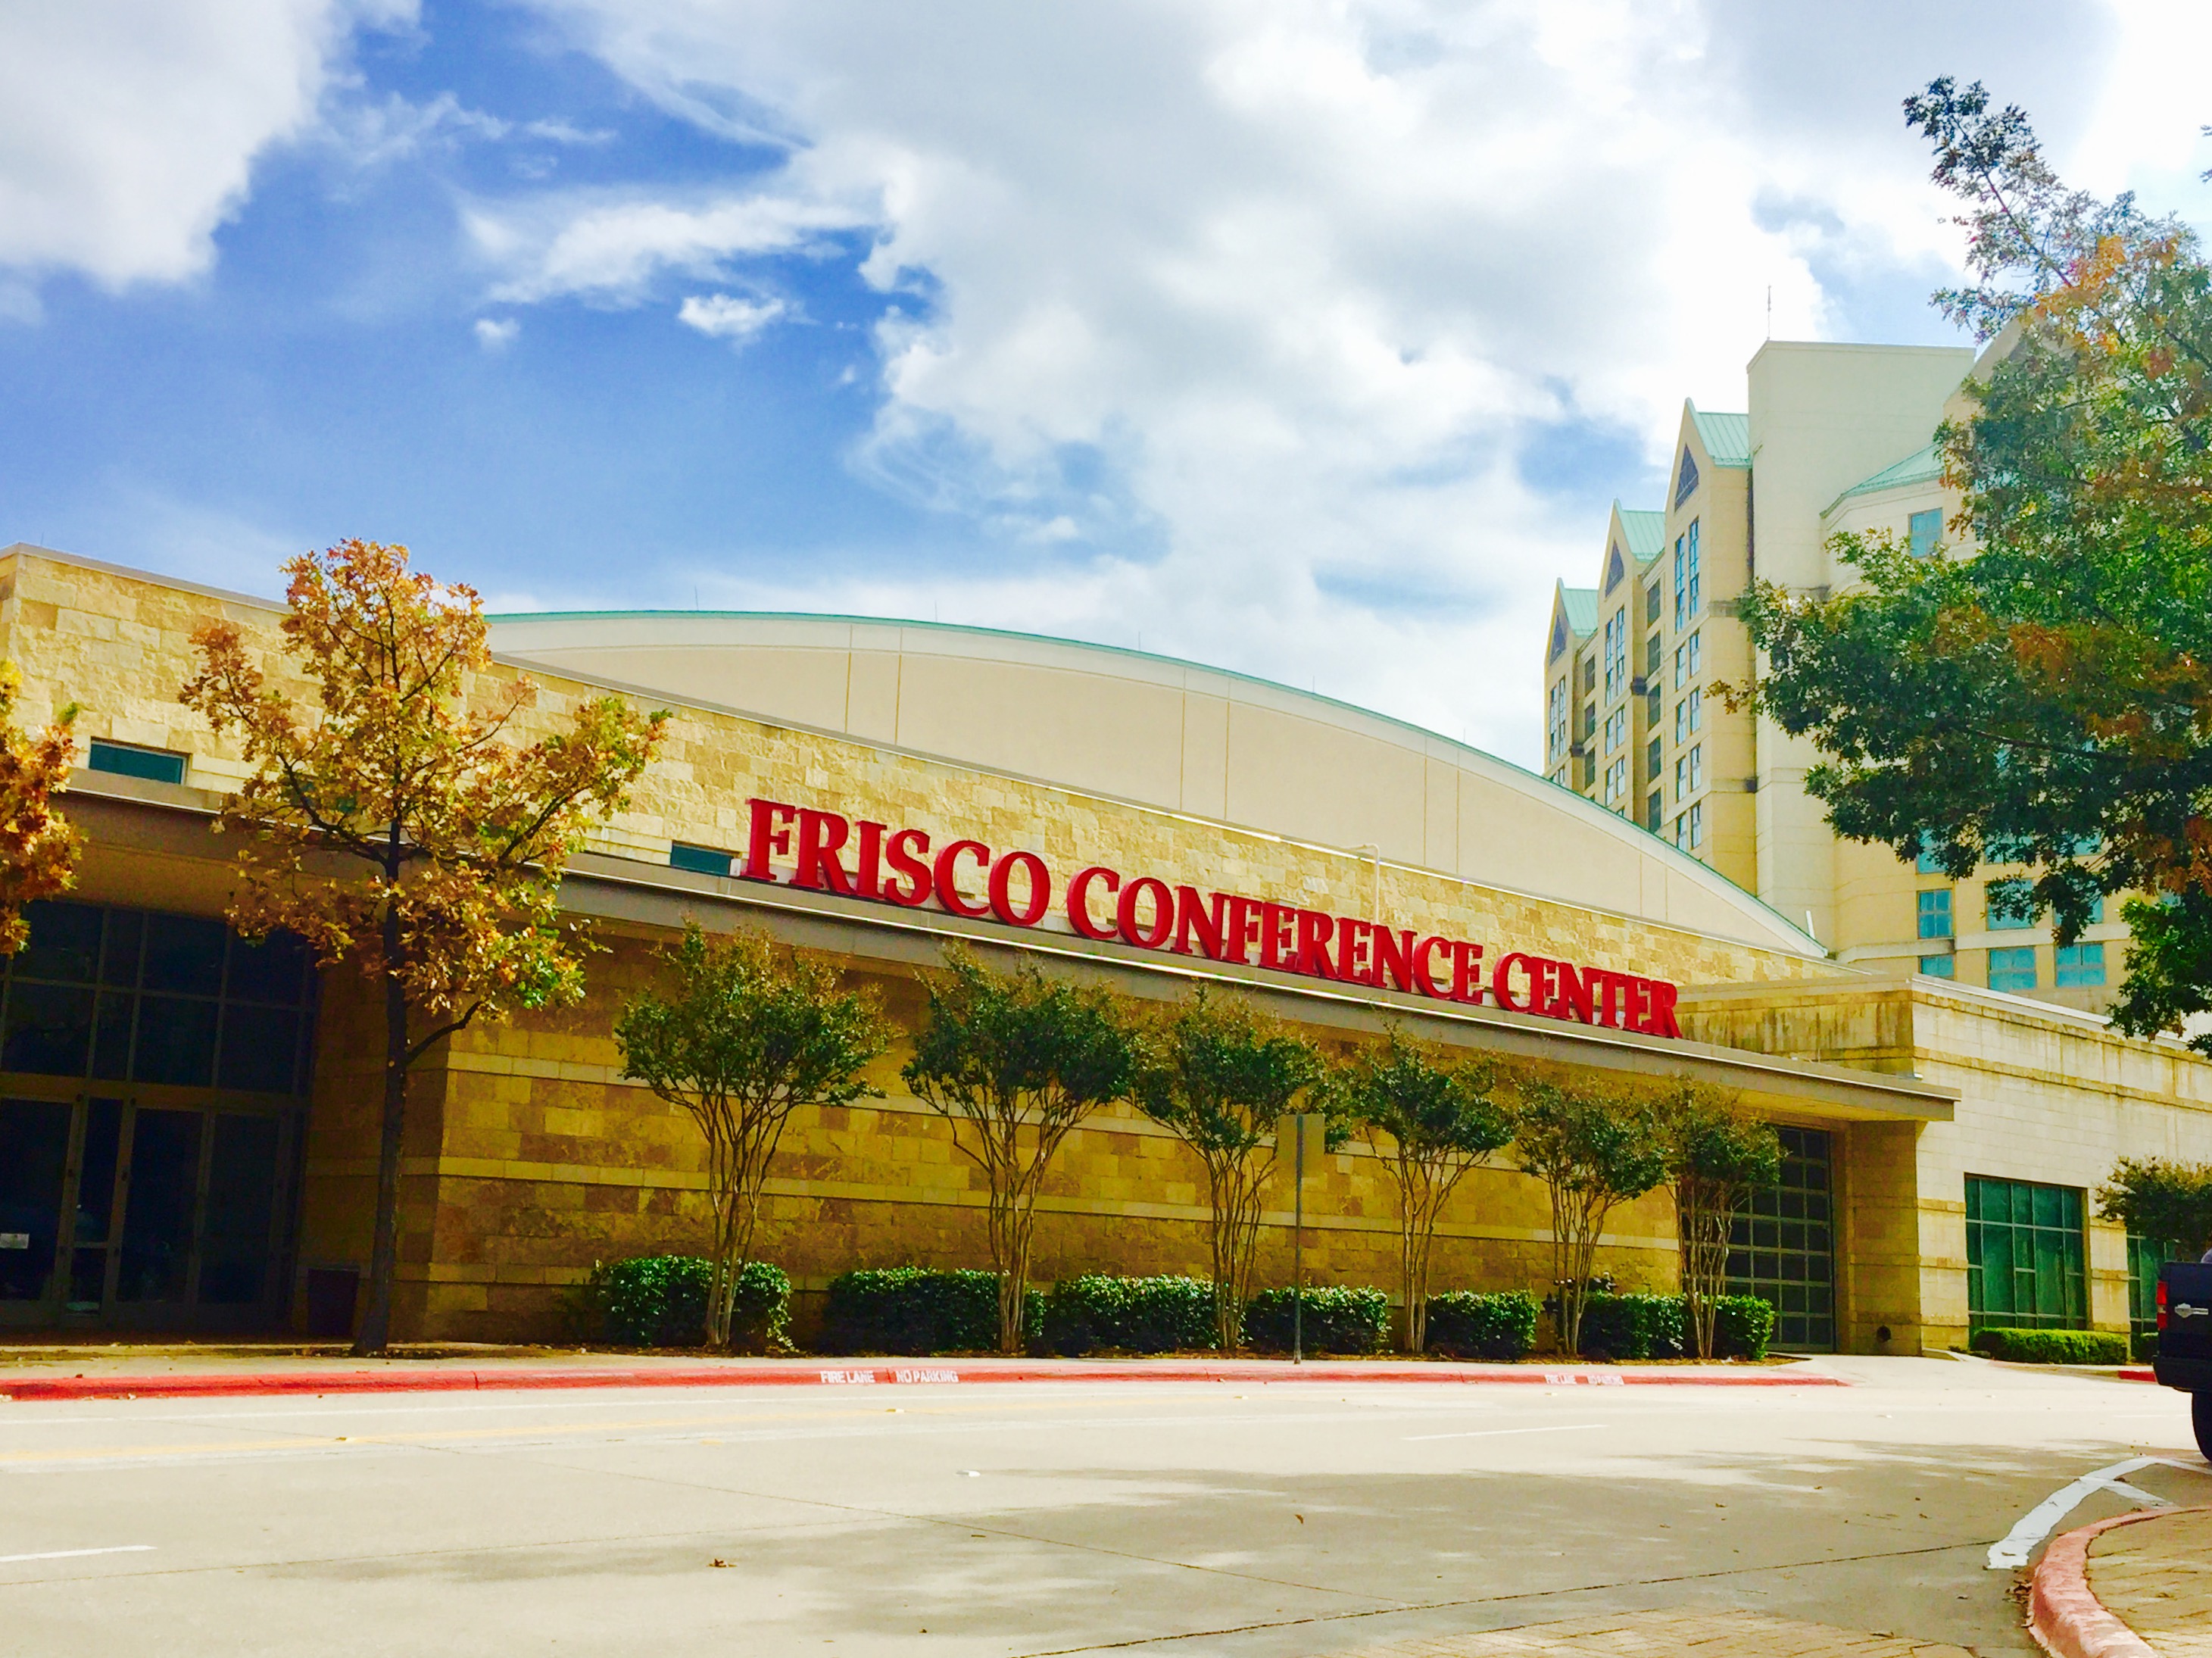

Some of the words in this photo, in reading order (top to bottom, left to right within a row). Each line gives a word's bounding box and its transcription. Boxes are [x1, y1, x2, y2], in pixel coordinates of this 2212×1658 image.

[741, 798, 1051, 927] FRISCO
[1066, 866, 1484, 1006] CONFERENCE
[1492, 952, 1683, 1039] CENTER
[819, 1370, 846, 1383] FIRE
[846, 1370, 875, 1383] LANE
[895, 1370, 910, 1383] NO
[913, 1370, 959, 1383] PARKING
